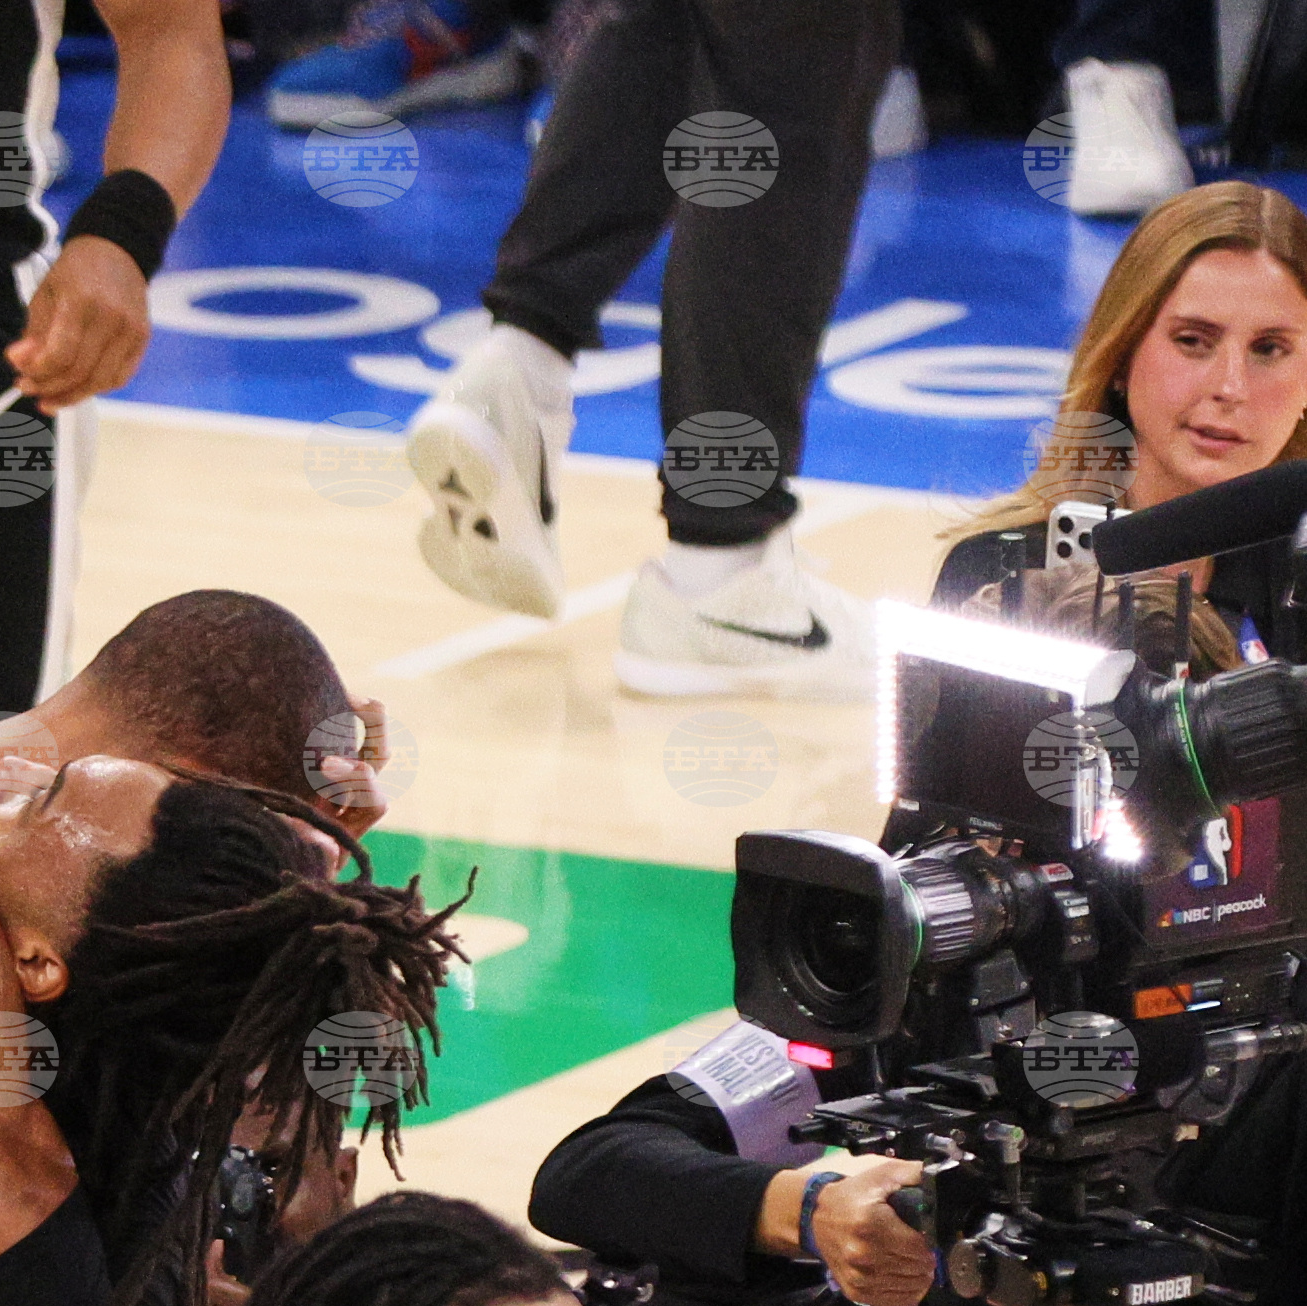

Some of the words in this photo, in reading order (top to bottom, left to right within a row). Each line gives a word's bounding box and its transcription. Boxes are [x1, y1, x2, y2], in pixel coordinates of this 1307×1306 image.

[1182, 906, 1211, 924] NBC
[1217, 893, 1267, 922] peacock
[1131, 1275, 1193, 1306] BARBER
